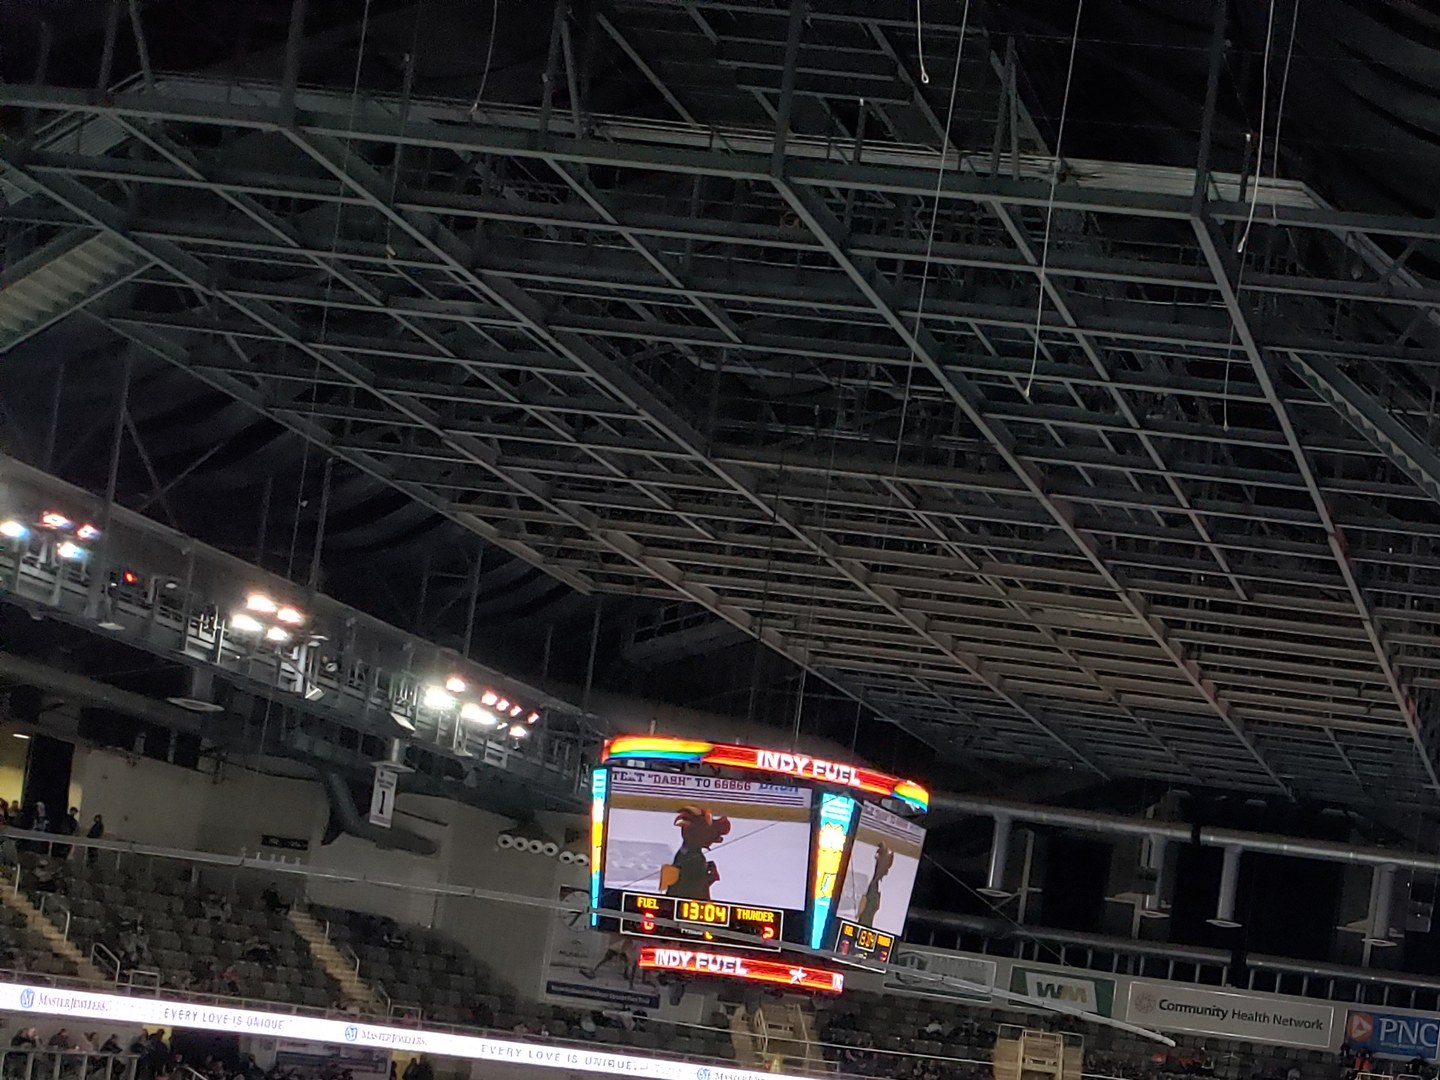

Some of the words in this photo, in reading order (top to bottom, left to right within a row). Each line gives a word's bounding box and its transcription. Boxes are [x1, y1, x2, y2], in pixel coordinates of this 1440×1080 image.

[756, 750, 810, 777] INDY
[812, 759, 861, 785] FUEL
[694, 778, 710, 788] TO
[636, 896, 660, 910] FUEL
[681, 901, 727, 922] 13:04
[736, 908, 774, 923] THUNDER
[655, 949, 694, 968] INDY
[695, 952, 748, 976] FUEL
[1035, 980, 1088, 1004] WM
[164, 1007, 198, 1023] EVERY
[201, 1011, 230, 1025] LOVE
[233, 1016, 242, 1027] IS
[246, 1017, 284, 1032] UNIQUE
[1158, 998, 1229, 1020] Community
[1231, 1007, 1271, 1024] Health
[1272, 1012, 1324, 1032] Network
[1380, 1017, 1438, 1048] PNC
[481, 1043, 523, 1059] EVERY
[528, 1047, 563, 1062] LOVE
[566, 1052, 578, 1064] IS
[585, 1054, 636, 1071] UNIQUE
